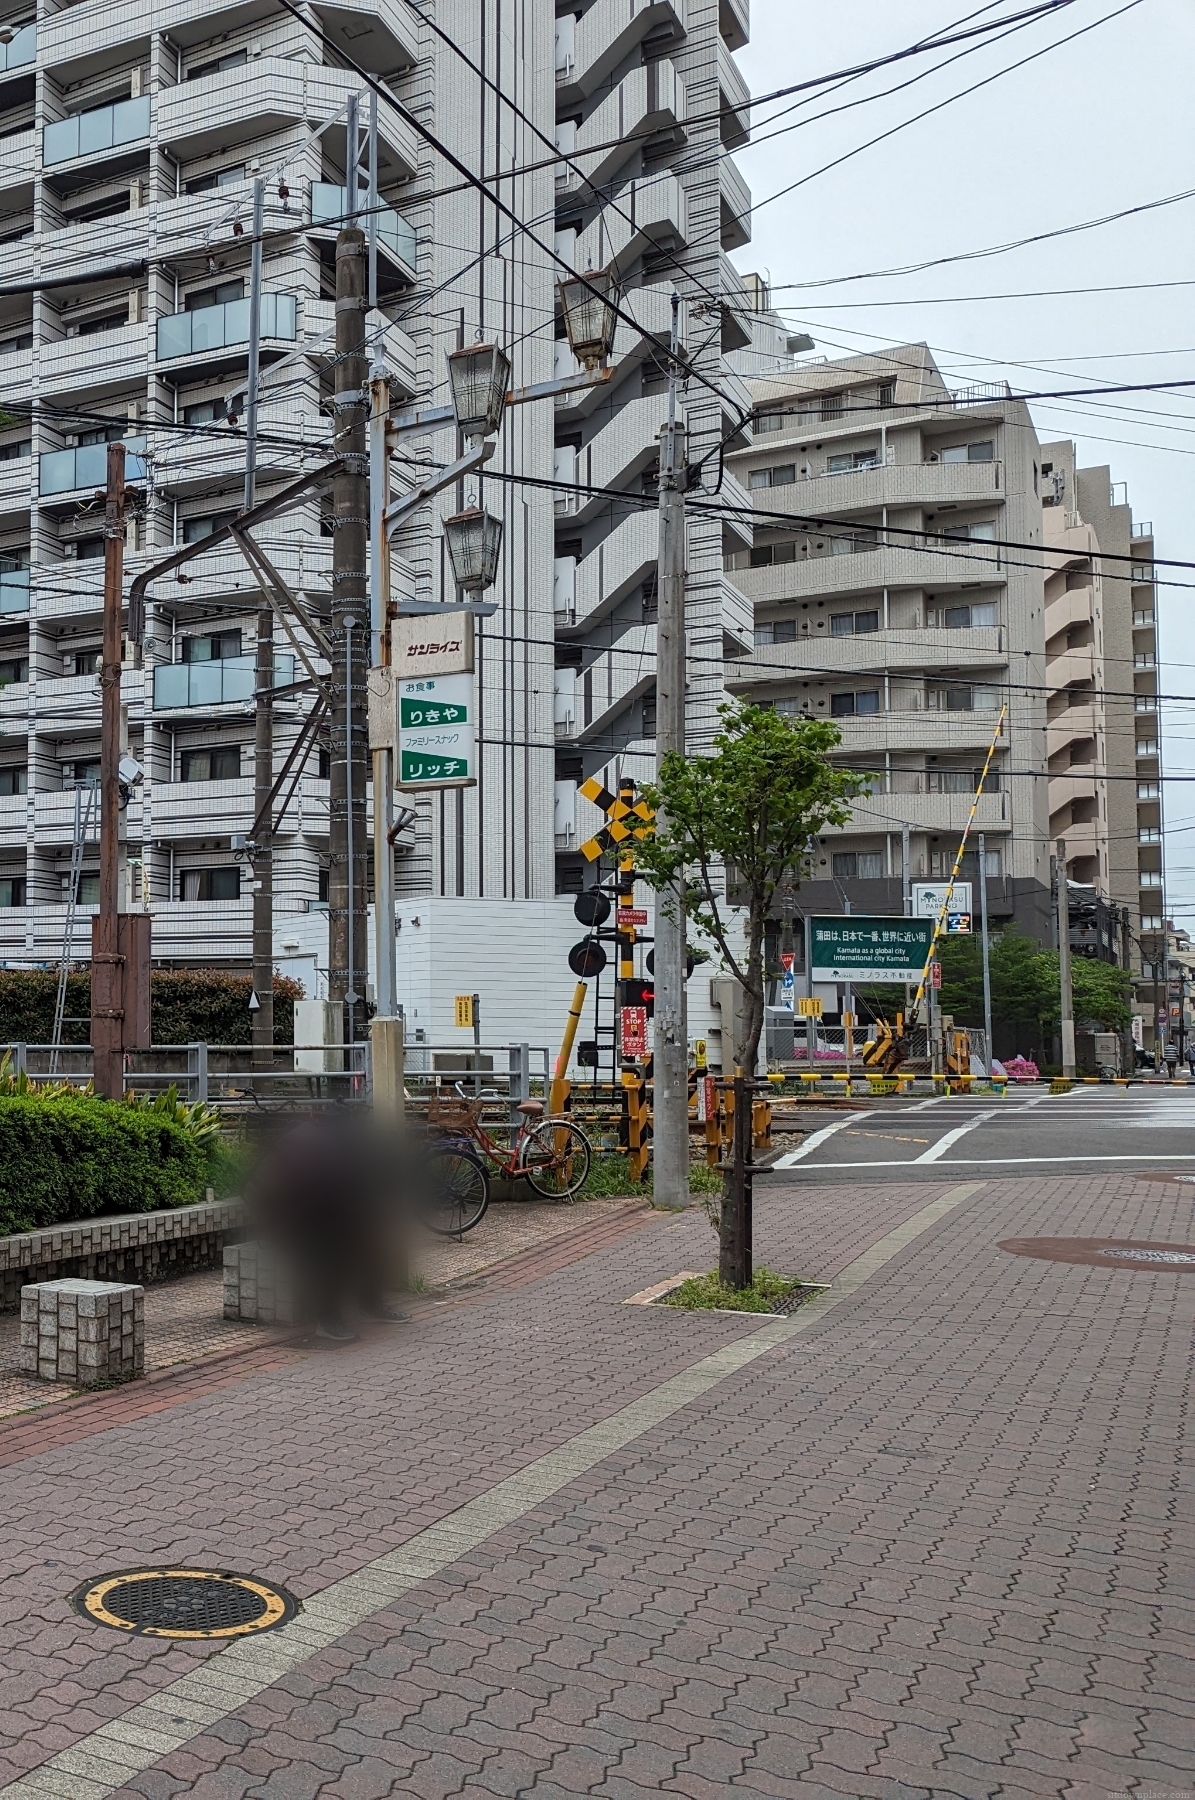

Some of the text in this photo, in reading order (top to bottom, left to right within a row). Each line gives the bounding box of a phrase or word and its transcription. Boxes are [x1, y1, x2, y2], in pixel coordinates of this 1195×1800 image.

[407, 640, 462, 657] サンライズ
[405, 681, 436, 693] お食事
[410, 707, 459, 725] りきや
[405, 734, 459, 748] ファミリースナック
[409, 760, 460, 778] リッチ
[816, 930, 927, 943] 蒲田は、日本で一番、世界に近い街
[874, 947, 894, 955] global
[894, 947, 906, 955] city
[833, 954, 873, 962] International
[873, 954, 885, 962] city
[859, 971, 913, 979] ミノラス不動産
[1173, 1008, 1179, 1016] P
